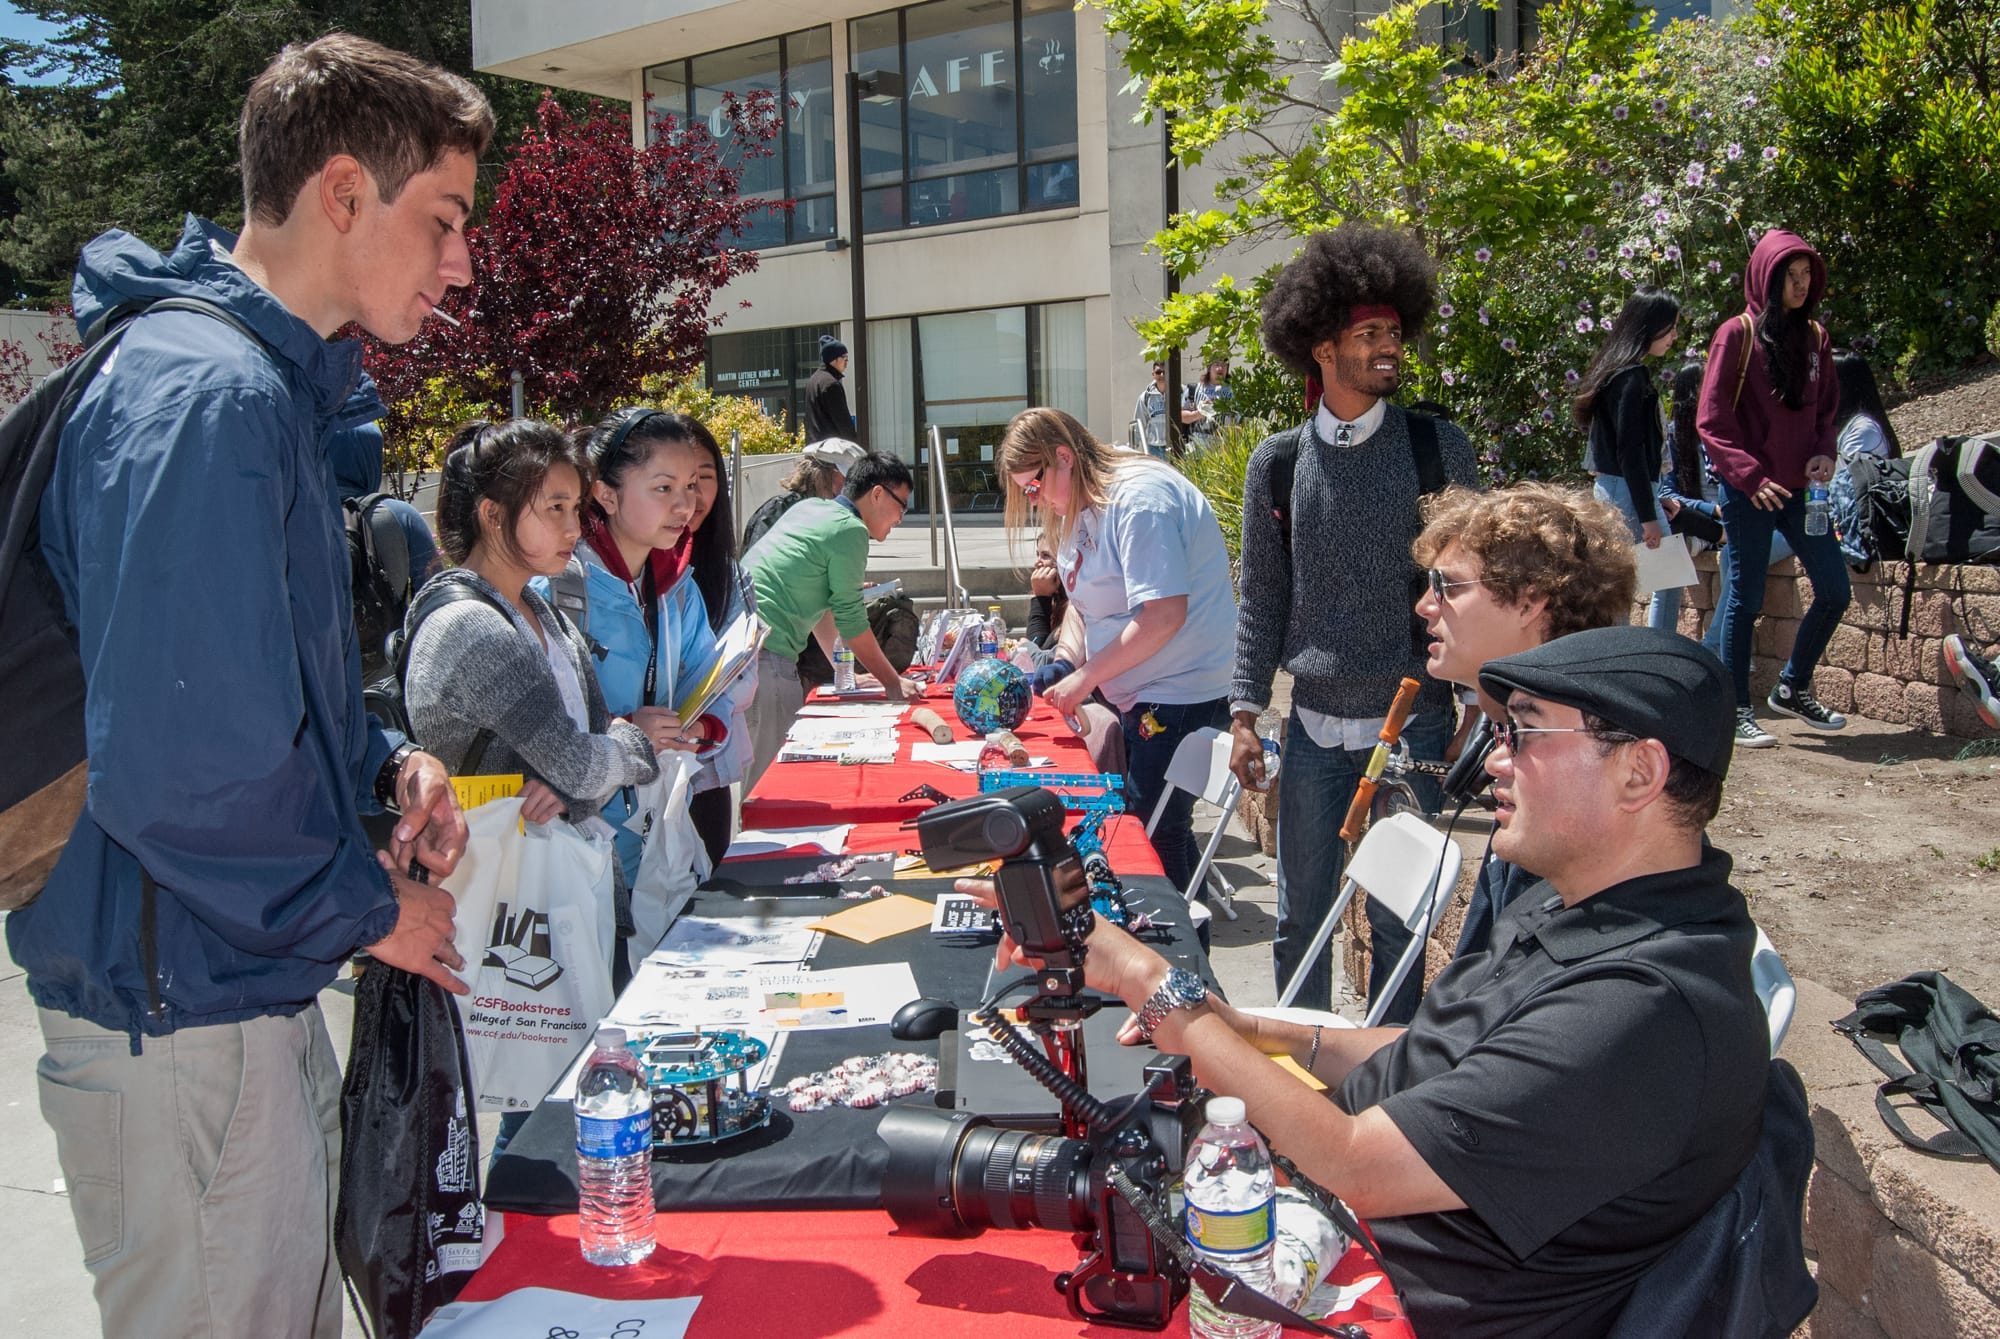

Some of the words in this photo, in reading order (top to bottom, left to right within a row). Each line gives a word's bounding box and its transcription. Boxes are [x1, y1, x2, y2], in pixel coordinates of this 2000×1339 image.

[881, 50, 1006, 106] AFE
[738, 371, 757, 379] LUTHER
[758, 369, 771, 378] KING
[738, 379, 760, 388] CENTER
[500, 1016, 512, 1026] of
[515, 1017, 537, 1028] San
[541, 1019, 587, 1031] Francisco
